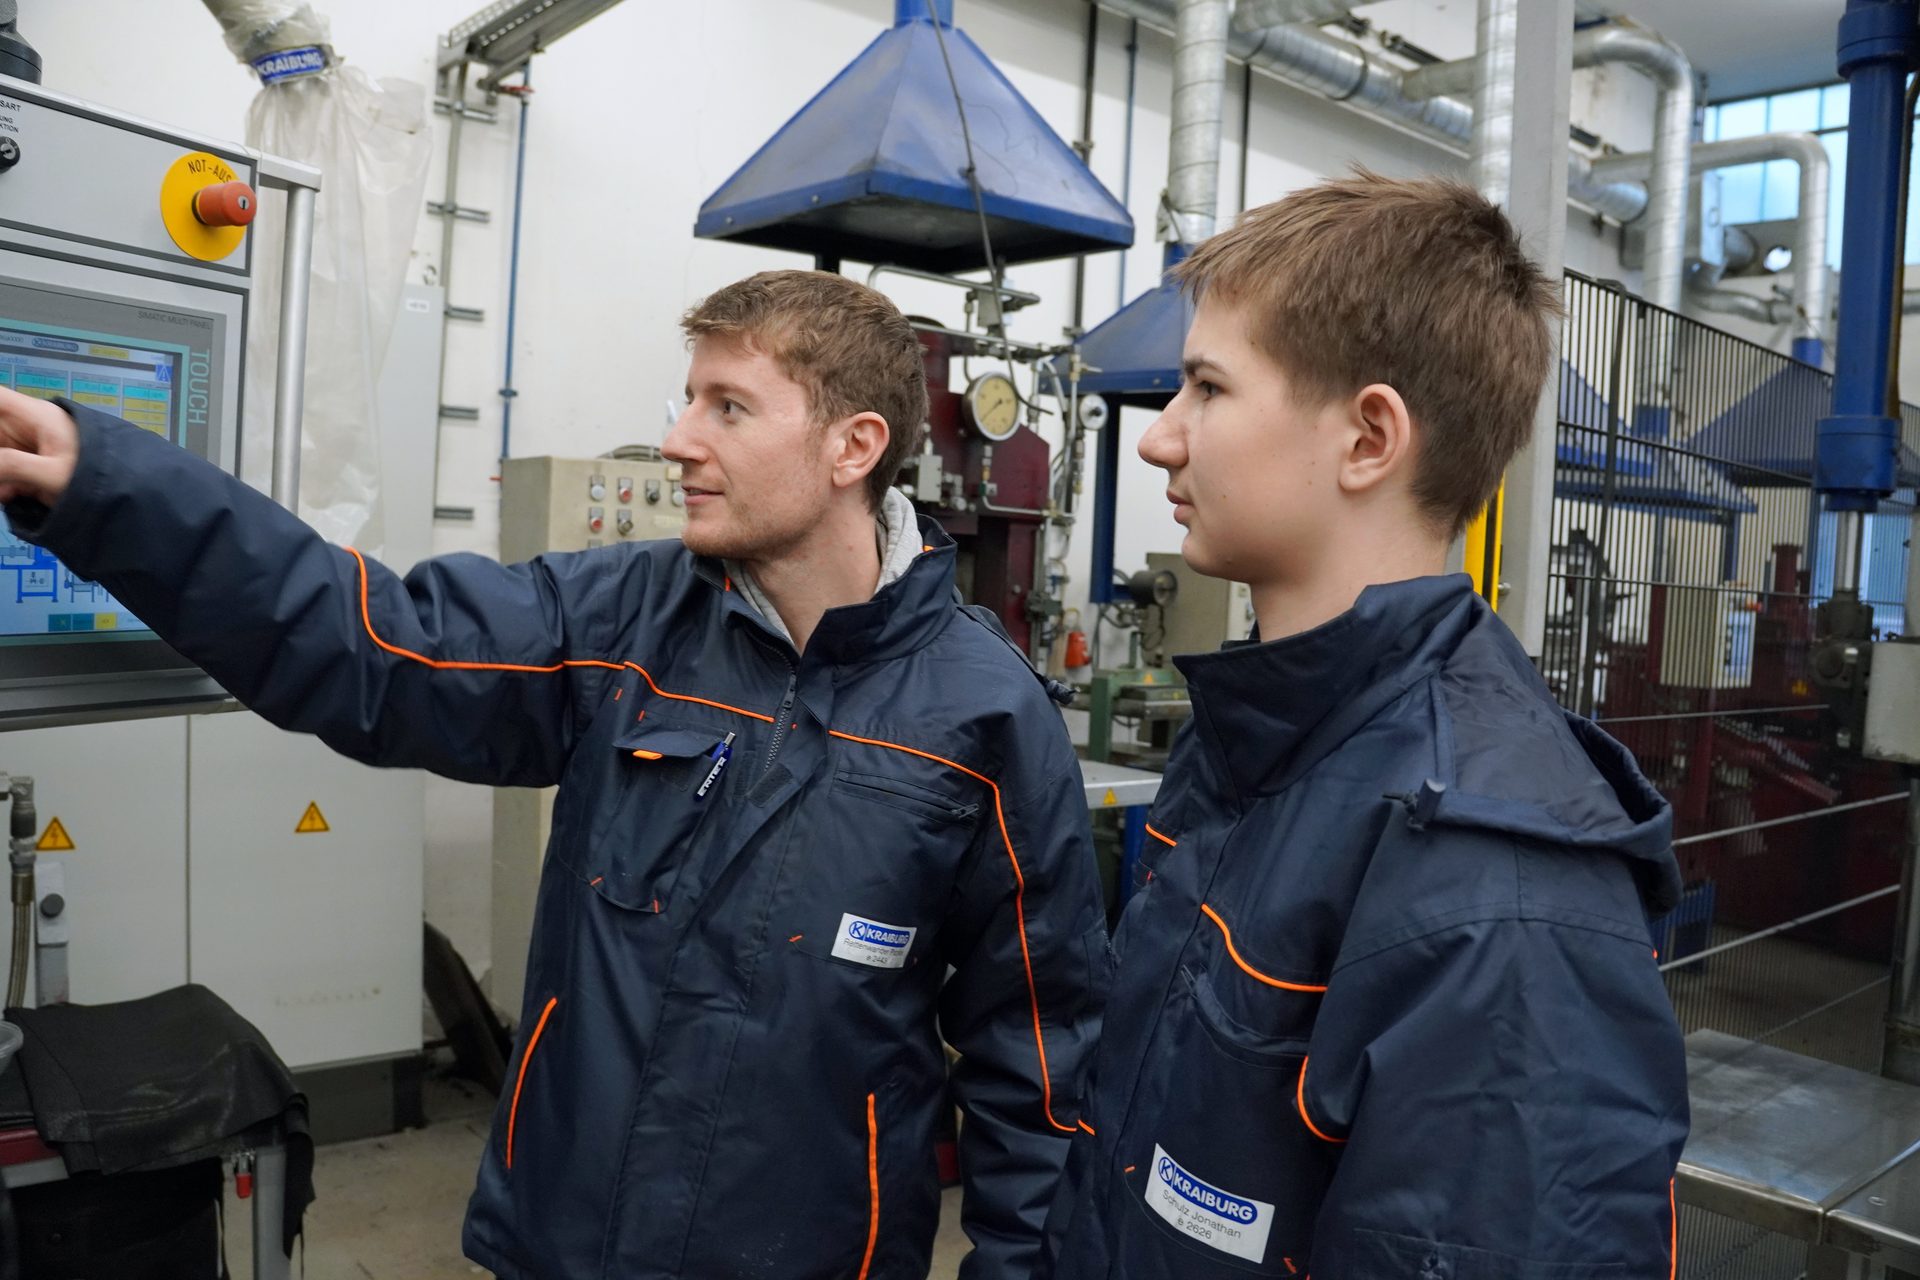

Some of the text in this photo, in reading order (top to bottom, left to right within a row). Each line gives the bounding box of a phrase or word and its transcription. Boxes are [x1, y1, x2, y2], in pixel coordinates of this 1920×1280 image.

[188, 349, 210, 424] TOUCH
[867, 928, 909, 944] KRAIBURG
[1162, 1189, 1242, 1239] Schulz Jonathan
[1174, 1172, 1253, 1220] KRAIBURG
[1186, 1221, 1212, 1240] 2626
